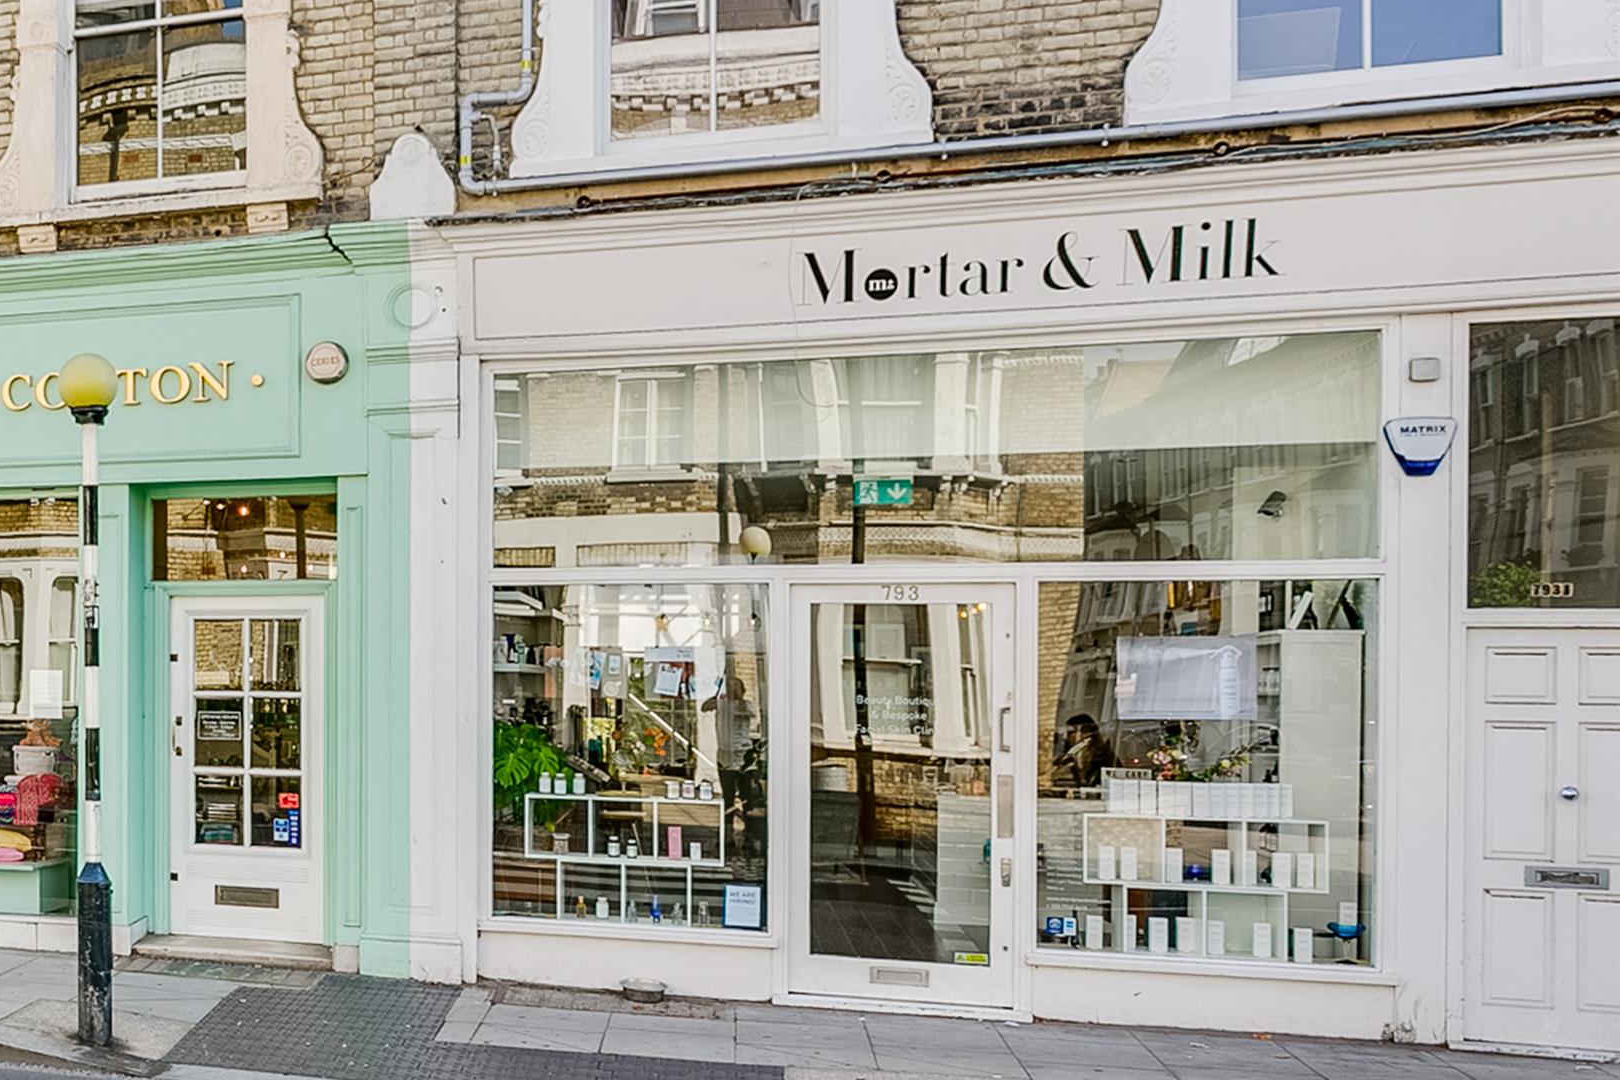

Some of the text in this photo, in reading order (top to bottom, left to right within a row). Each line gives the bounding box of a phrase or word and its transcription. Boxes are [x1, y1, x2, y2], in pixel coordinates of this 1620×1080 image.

[1042, 231, 1101, 291] &
[1115, 217, 1287, 287] Milk
[0, 360, 235, 411] COTON
[1400, 425, 1446, 433] MATRIX
[881, 585, 920, 601] 793
[894, 695, 936, 708] Boutiqu
[882, 710, 928, 722] Bespoke
